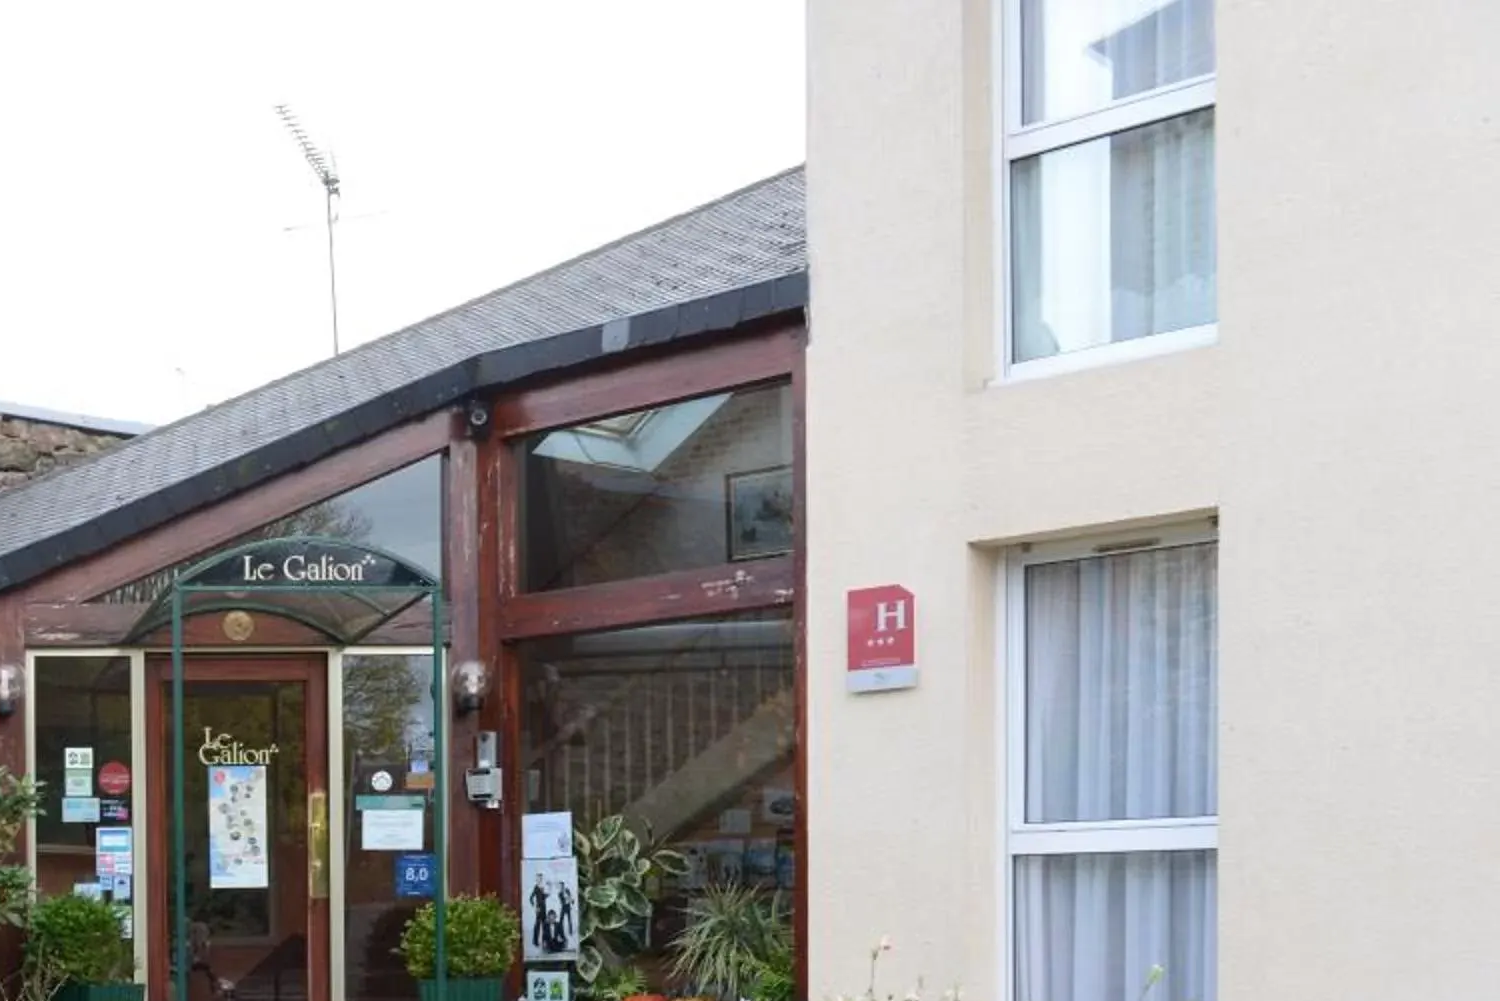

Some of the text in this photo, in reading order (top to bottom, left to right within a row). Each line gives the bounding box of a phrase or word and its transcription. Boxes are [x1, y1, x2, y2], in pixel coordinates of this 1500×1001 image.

[243, 553, 364, 581] Le Galion
[876, 599, 908, 632] H
[204, 726, 233, 749] Le
[199, 742, 271, 765] Galion
[405, 867, 429, 882] 8,0
